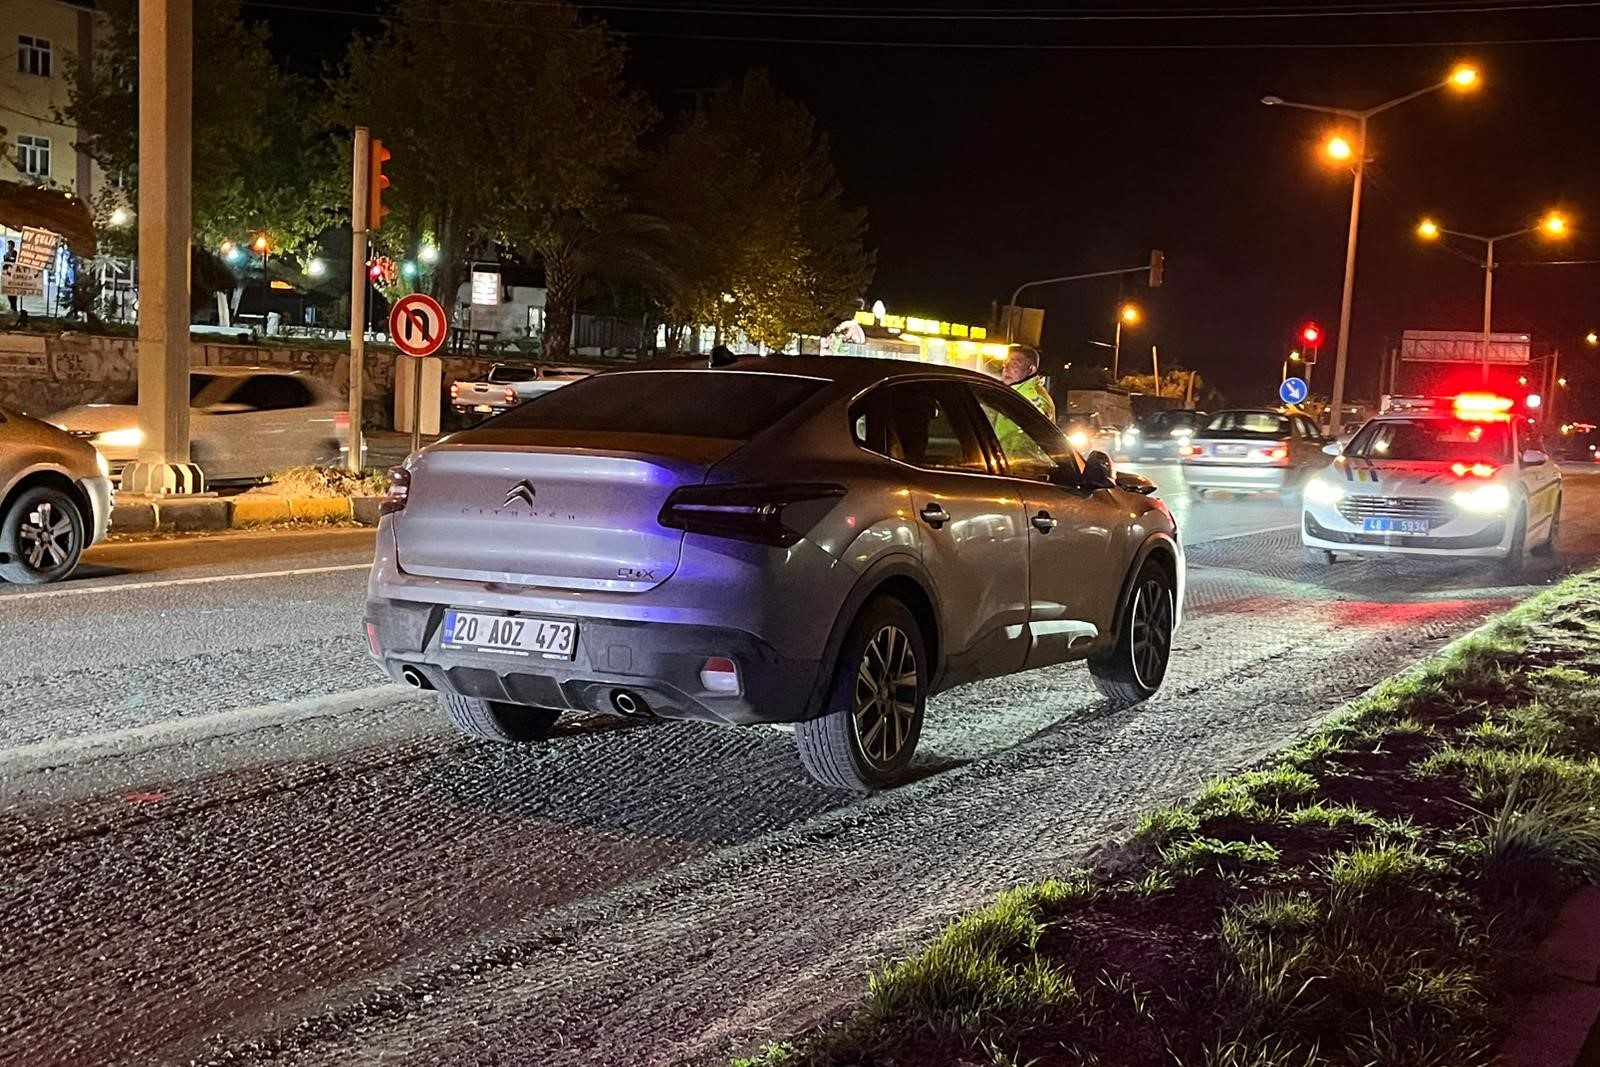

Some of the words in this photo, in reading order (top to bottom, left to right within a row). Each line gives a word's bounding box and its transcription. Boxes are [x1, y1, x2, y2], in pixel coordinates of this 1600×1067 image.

[1369, 520, 1382, 530] 48
[1401, 520, 1426, 532] 5934
[454, 616, 479, 641] 20
[487, 619, 525, 646] AOZ
[535, 623, 572, 651] 473
